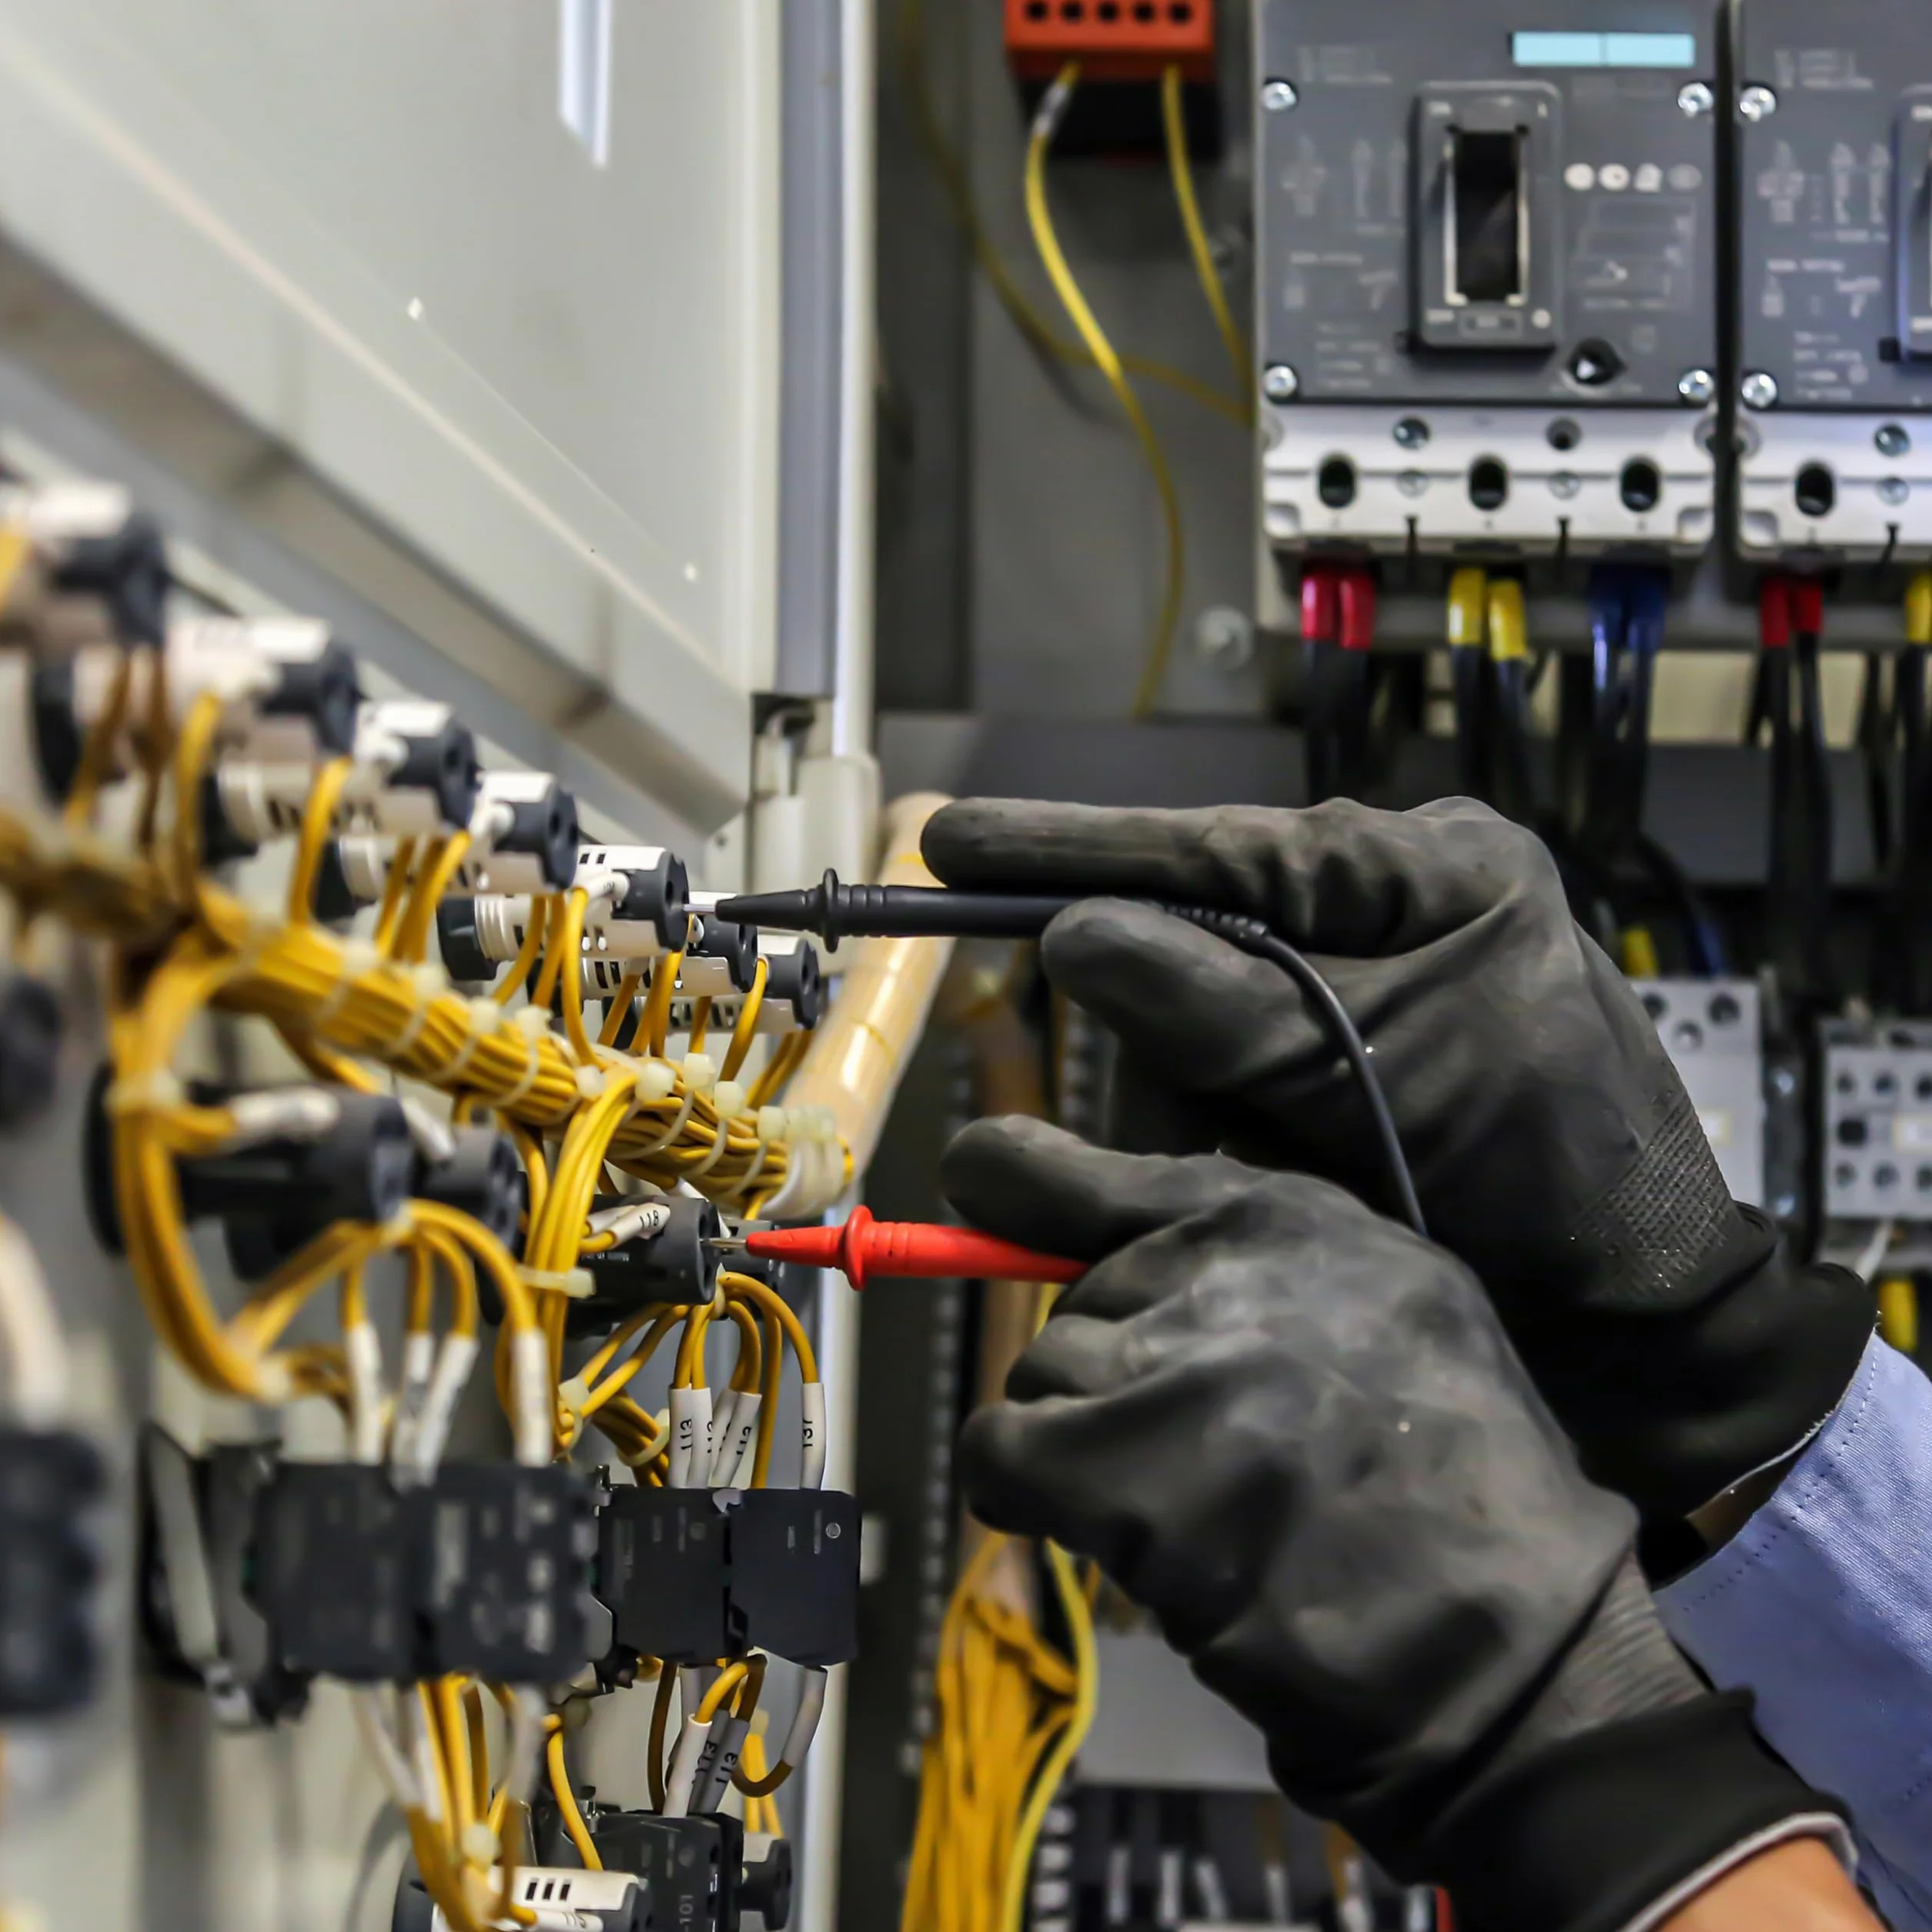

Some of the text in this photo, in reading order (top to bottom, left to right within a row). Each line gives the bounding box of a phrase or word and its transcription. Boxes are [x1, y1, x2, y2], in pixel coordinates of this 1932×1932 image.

[640, 1209, 659, 1230] 118
[680, 1418, 693, 1450] 113
[715, 1752, 738, 1784] 113
